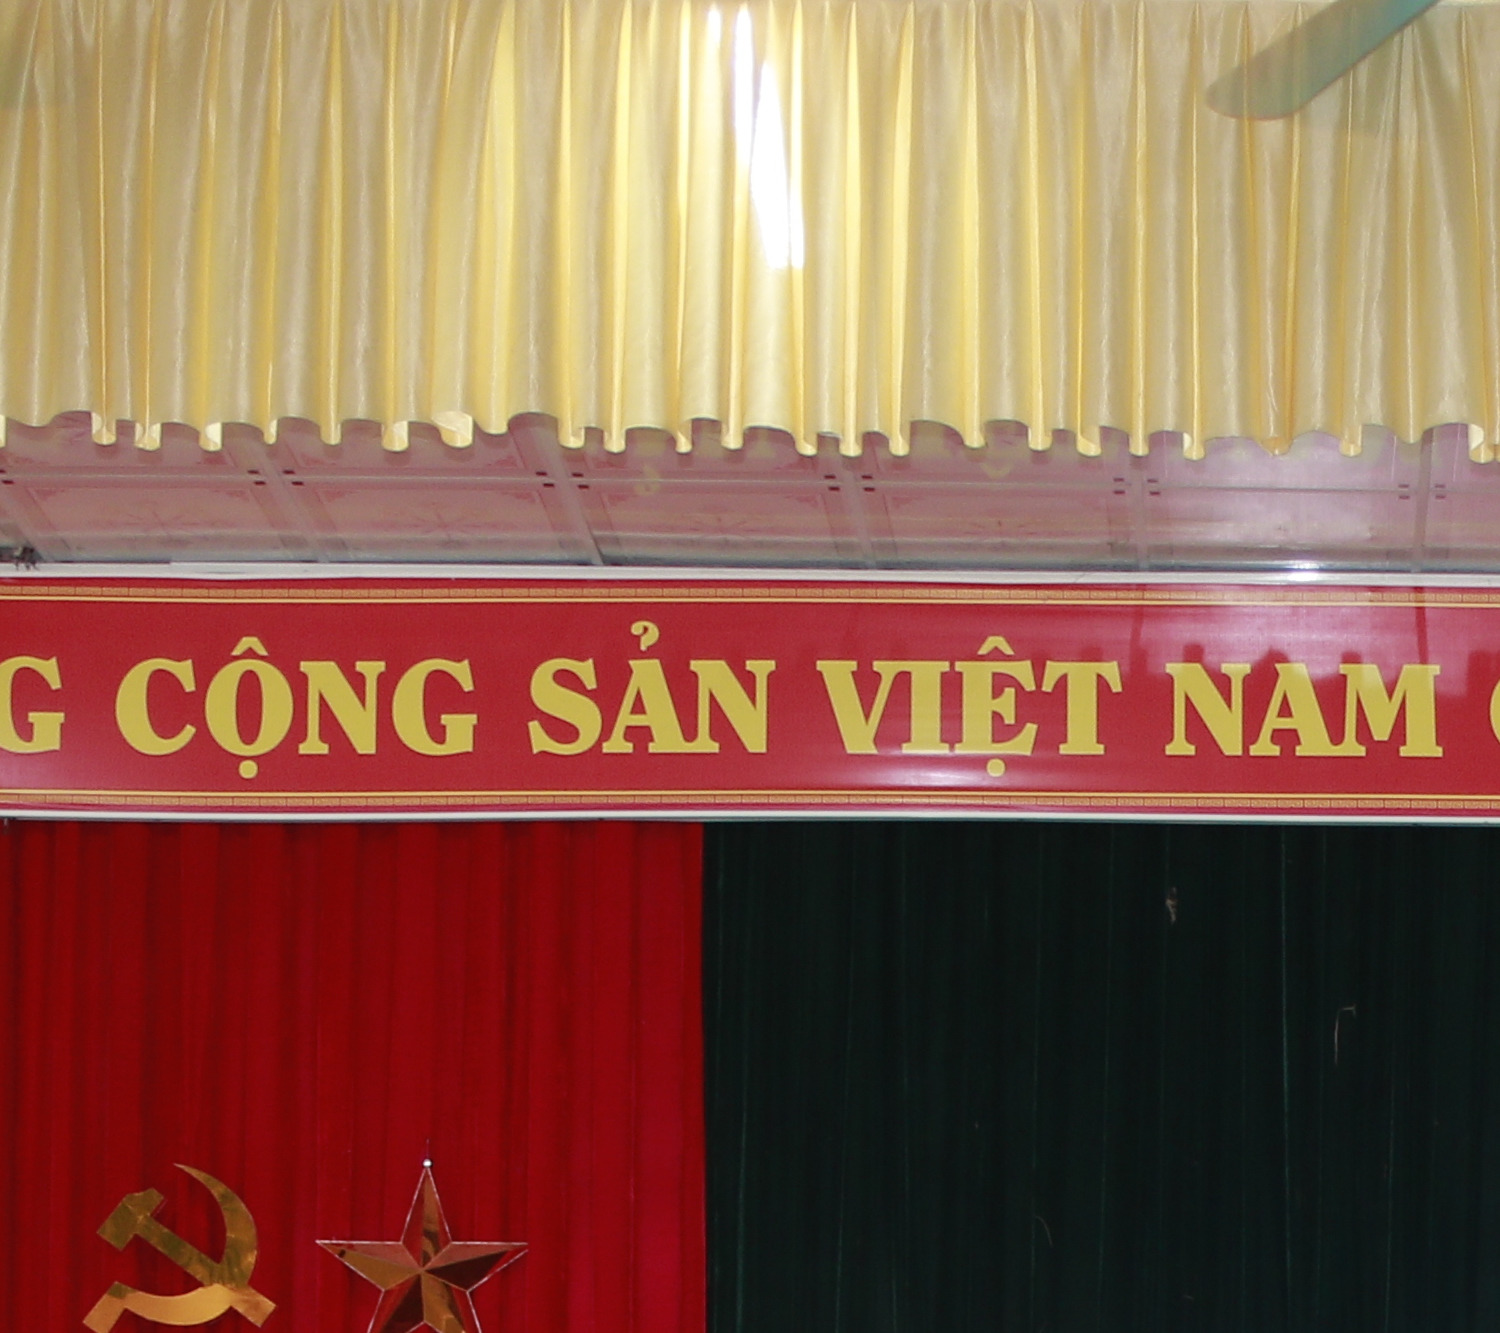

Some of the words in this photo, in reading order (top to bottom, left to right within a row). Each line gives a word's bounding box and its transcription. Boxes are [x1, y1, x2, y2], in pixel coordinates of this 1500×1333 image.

[113, 634, 480, 780] CỘNG
[527, 621, 774, 757] SẢN
[815, 636, 1120, 778] VIỆT
[1164, 662, 1443, 759] NAM
